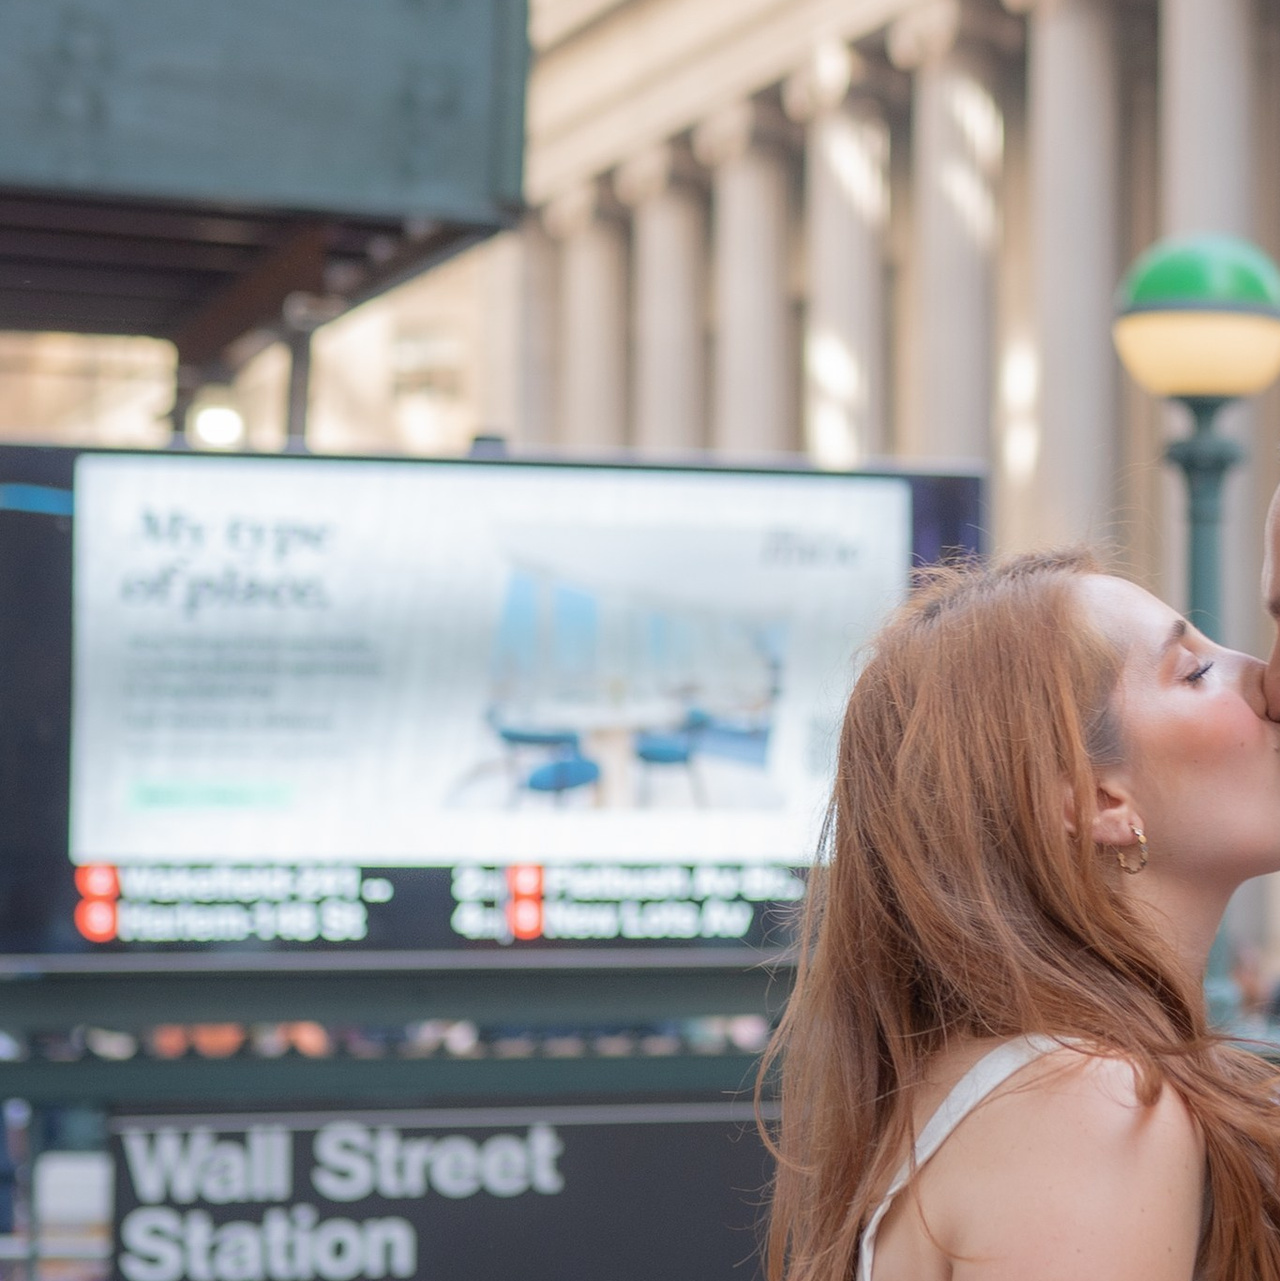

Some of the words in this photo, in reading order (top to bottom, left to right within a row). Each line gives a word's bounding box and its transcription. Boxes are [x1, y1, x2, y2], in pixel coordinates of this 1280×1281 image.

[225, 516, 338, 567] type
[121, 1125, 294, 1205] Wall
[310, 1121, 565, 1203] Street
